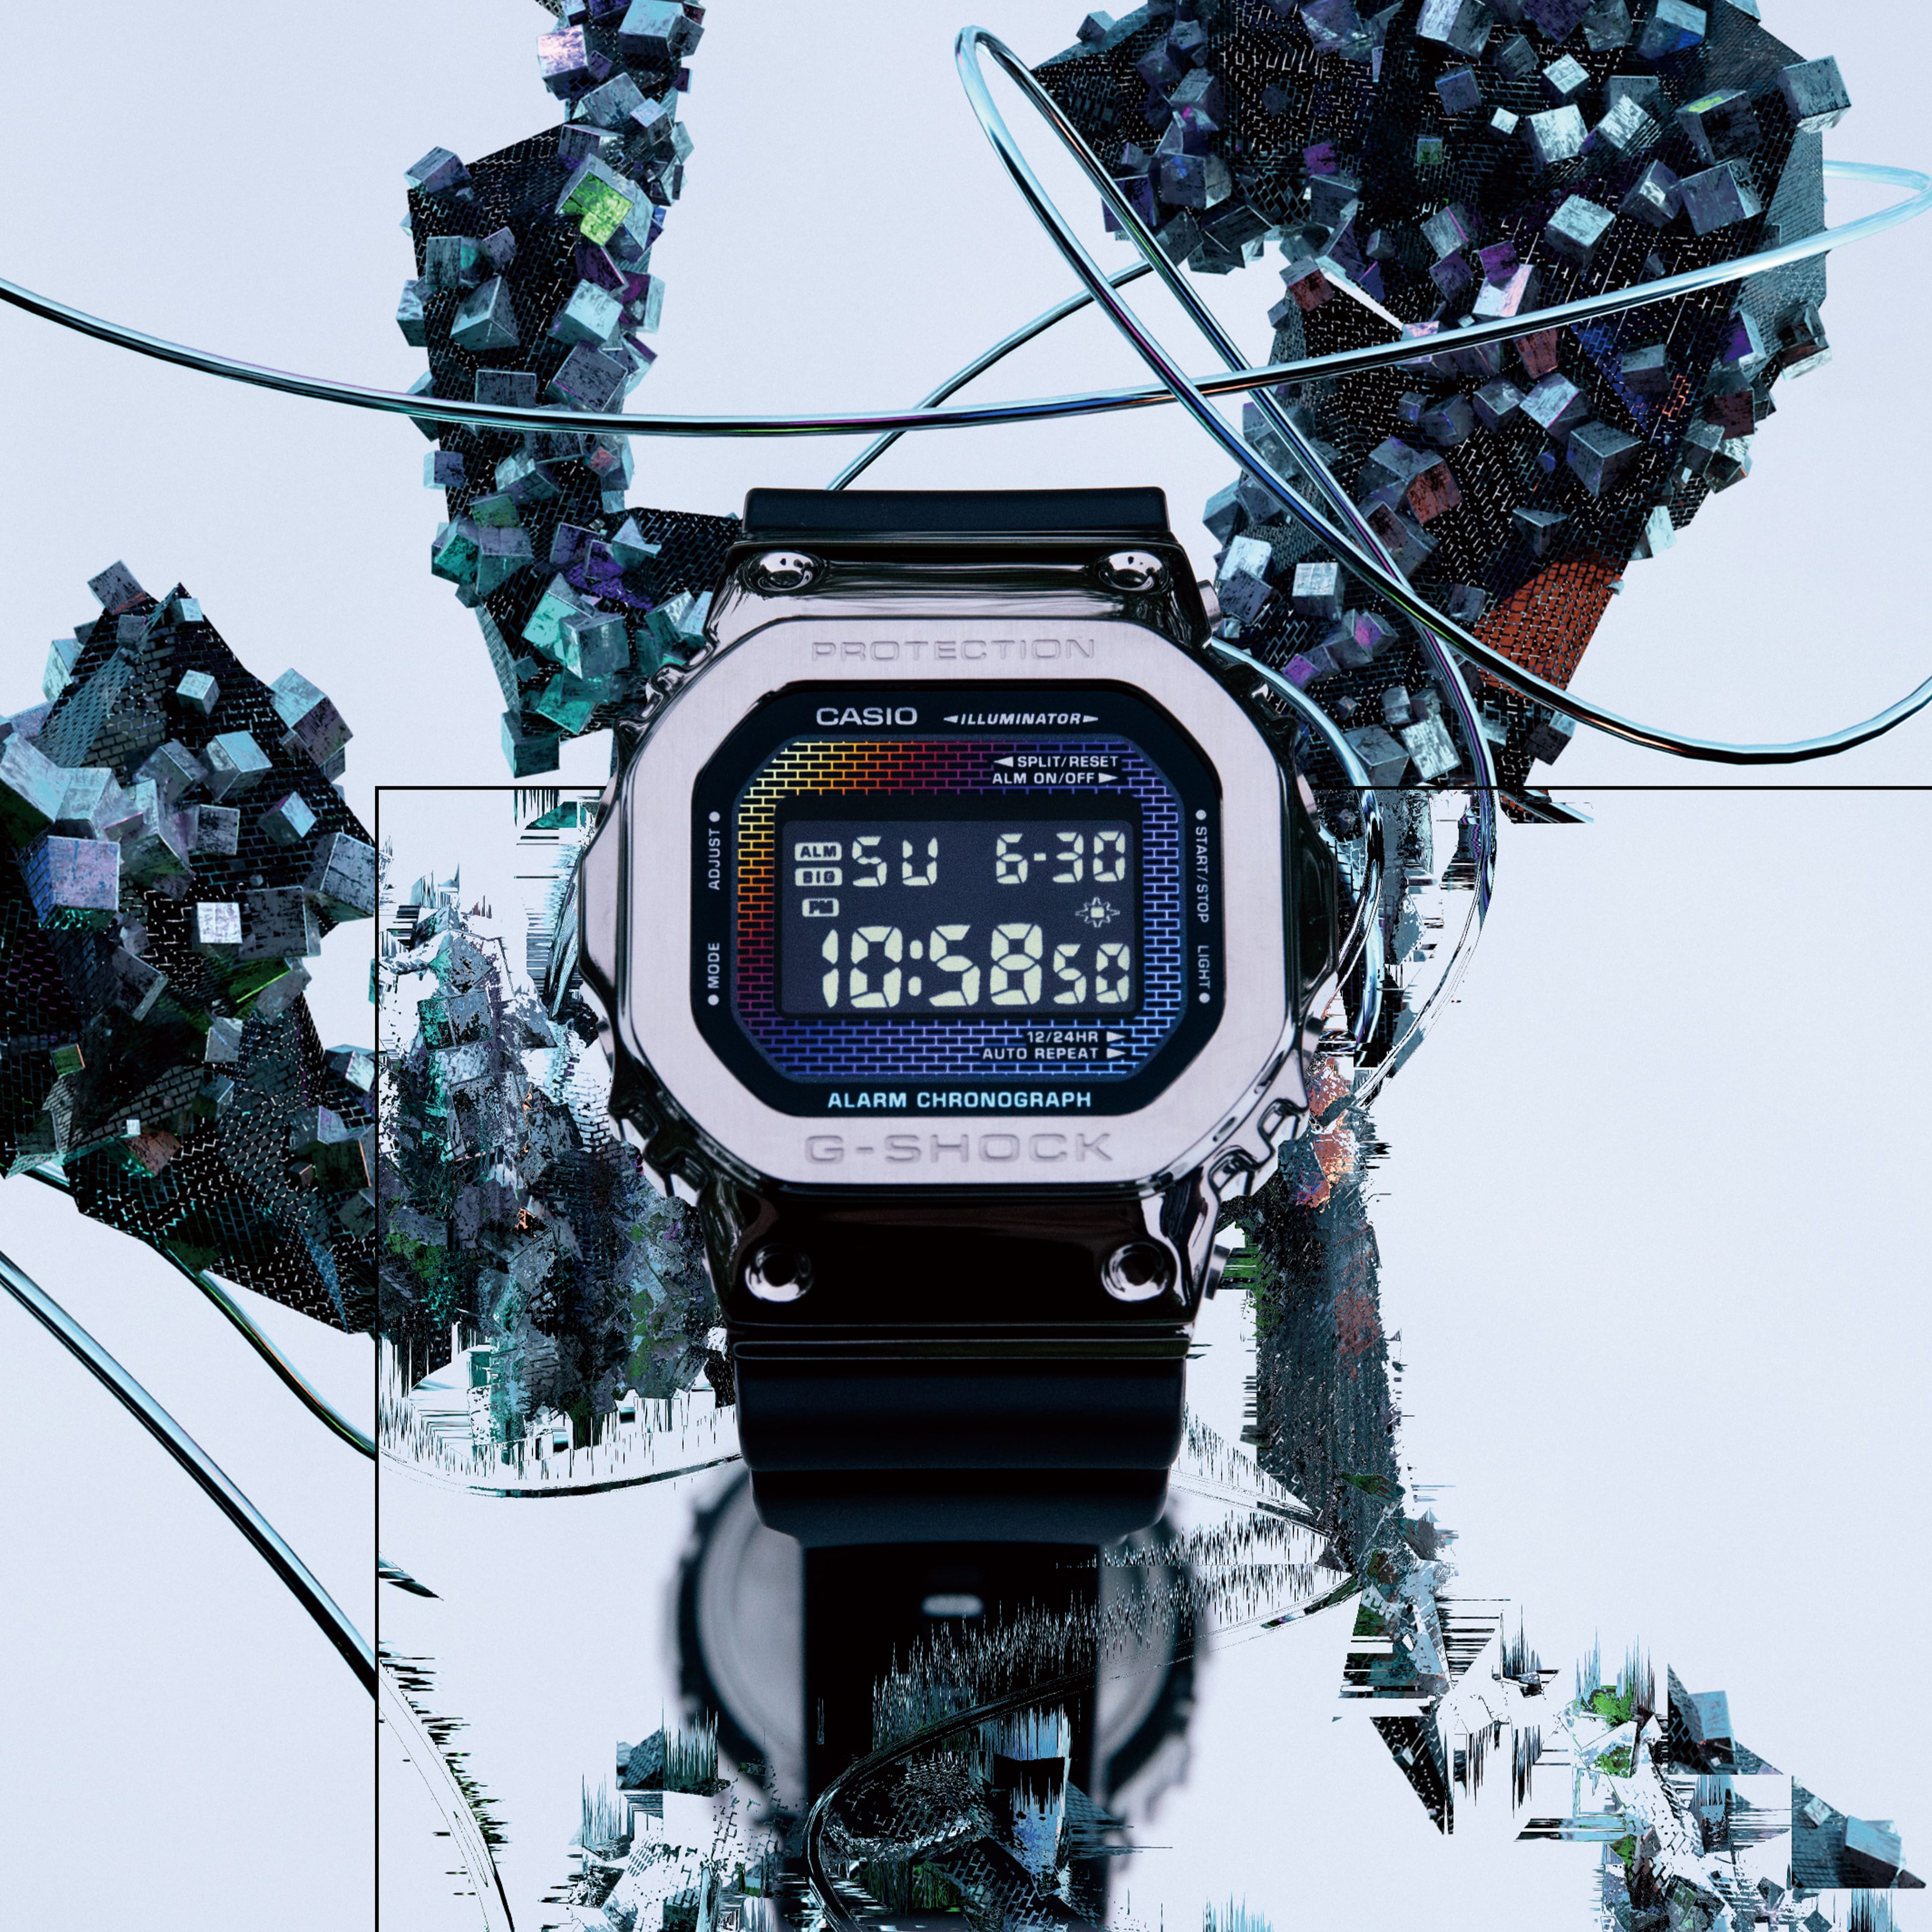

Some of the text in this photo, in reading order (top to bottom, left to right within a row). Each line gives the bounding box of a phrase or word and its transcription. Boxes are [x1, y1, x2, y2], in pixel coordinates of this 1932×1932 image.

[812, 639, 1094, 661] PROTECTION
[816, 706, 918, 726] CASIO
[960, 713, 1081, 725] ILLUMINATOR
[1017, 755, 1118, 768] SPLIT/RESET
[992, 772, 1095, 784] ALM ON/OFF
[707, 828, 720, 891] ADJUST
[800, 845, 836, 858] ALM
[996, 831, 1126, 885] 6-30
[1195, 826, 1210, 923] START/STOP
[707, 942, 720, 989] MODE
[1197, 945, 1211, 989] LIGHT
[1026, 1031, 1098, 1044] 12/24HR
[982, 1048, 1099, 1060] AUTO REPEAT
[828, 1091, 1091, 1108] ALARM CHRONOGRAPH
[805, 1133, 1113, 1163] G-SHOCK
